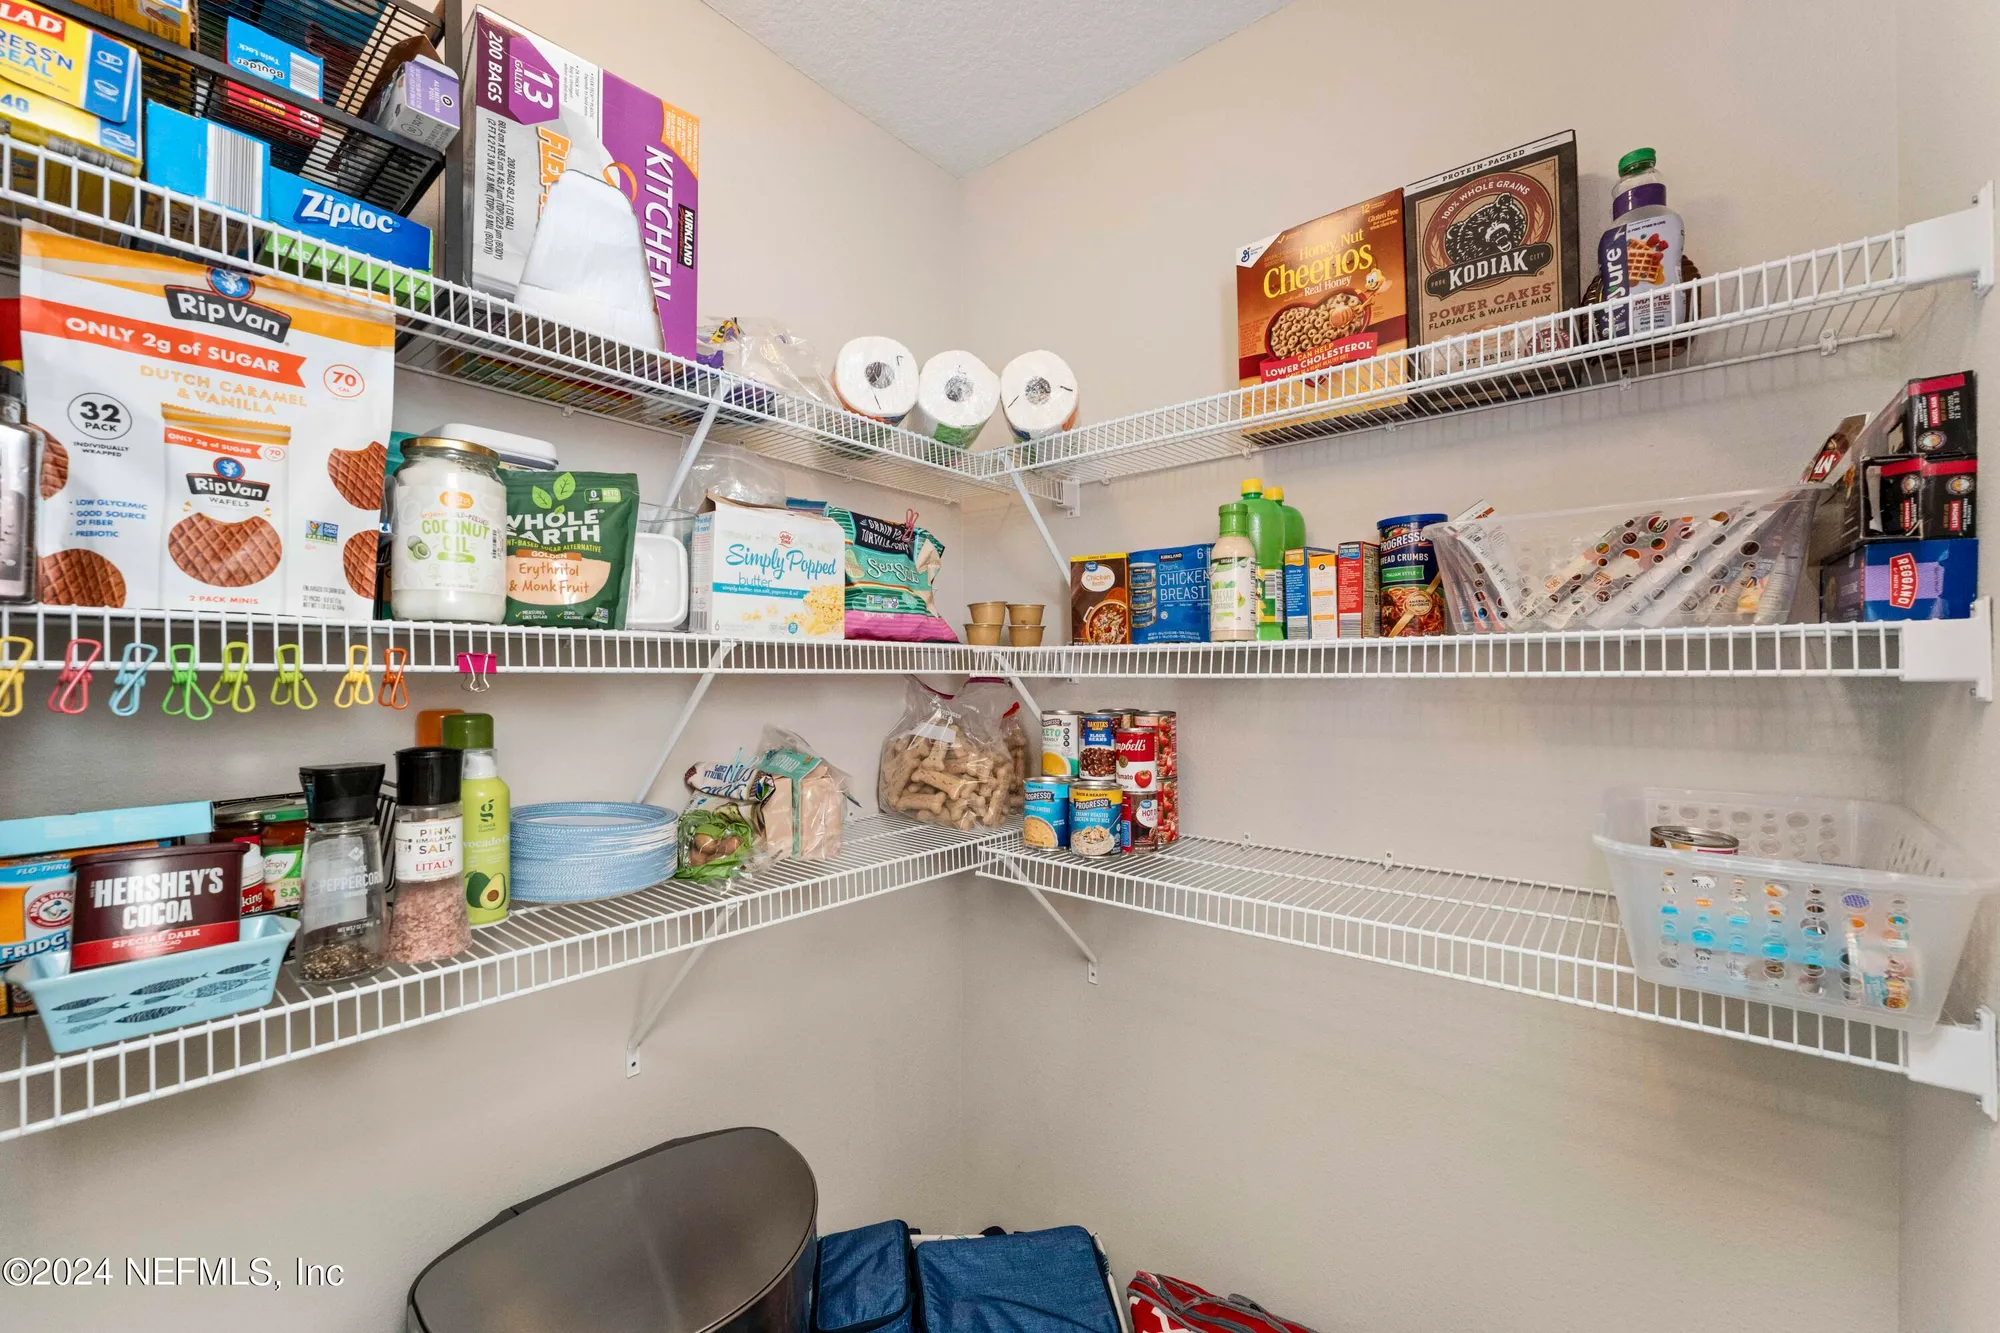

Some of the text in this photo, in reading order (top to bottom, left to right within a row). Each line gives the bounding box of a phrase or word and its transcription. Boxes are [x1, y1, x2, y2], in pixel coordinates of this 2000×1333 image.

[238, 57, 285, 79] Boulder
[487, 30, 503, 104] 200 BAGS
[514, 59, 554, 110] 13 GALLON
[507, 157, 516, 169] 200
[1442, 149, 1526, 182] PROTEIN-PACKED
[507, 169, 515, 186] BAGS
[506, 186, 515, 200] 49.2
[1441, 180, 1531, 220] 100% WHOLE GRAINS
[300, 188, 393, 233] Ziploc
[1361, 203, 1371, 214] 12
[504, 216, 514, 231] GAL)
[644, 145, 674, 301] KITCHEN
[683, 209, 695, 266] KIRKLAND
[1300, 239, 1337, 261] Honey
[1340, 228, 1365, 247] Nut
[1263, 243, 1373, 299] Cheerios
[1449, 249, 1528, 291] KODIAK
[1529, 252, 1545, 261] CITY
[1304, 275, 1353, 297] Real Honey
[1428, 282, 1552, 322] POWER CAKES
[177, 293, 281, 337] Rip Van
[1428, 294, 1552, 330] FLAPJACK & WAFFLE MIX
[65, 317, 281, 374] ONLY 2g of SUGAR
[1298, 342, 1334, 362] CAN HELP
[1265, 340, 1373, 378] LOWER CHOLESTEROL
[140, 364, 308, 407] DUTCH CARAMEL
[332, 371, 358, 387] 70
[177, 388, 277, 415] & VANILLA
[80, 401, 121, 423] 32
[85, 421, 117, 432] PACK
[73, 441, 130, 452] INDIVIDUALLY
[82, 448, 122, 457] WRAPPED
[167, 432, 193, 443] ONLY
[196, 438, 208, 448] 2g
[221, 444, 252, 454] SUGAR
[194, 477, 263, 498] Rip Van
[97, 499, 148, 510] GLYCEMIC
[209, 496, 250, 508] WAFELS
[105, 511, 146, 519] SOURCE
[868, 519, 893, 536] GRAIN
[531, 552, 568, 560] GOLDEN
[563, 544, 602, 553] ALTERNATIVE
[1197, 548, 1204, 559] 6
[1397, 553, 1429, 562] CRUMBS
[519, 562, 580, 580] Erythritol
[726, 543, 836, 580] Simply Popped
[867, 557, 895, 579] Sea
[1159, 563, 1180, 571] Chunk
[509, 580, 590, 594] & Monk Fruit
[739, 572, 773, 588] butter
[1086, 574, 1111, 582] Chicken
[1897, 557, 1910, 605] REGGANO
[189, 595, 259, 605] 2 PACK MINIS
[1160, 585, 1206, 601] BREAST
[714, 620, 720, 631] 6
[1075, 799, 1109, 810] PROGRESSO
[420, 826, 451, 837] PINK
[419, 842, 452, 855] SALT
[415, 859, 454, 872] LITALY
[93, 867, 224, 909] HERSHEY'S
[122, 899, 193, 930] COCOA
[112, 929, 201, 949] SPECIAL DARK
